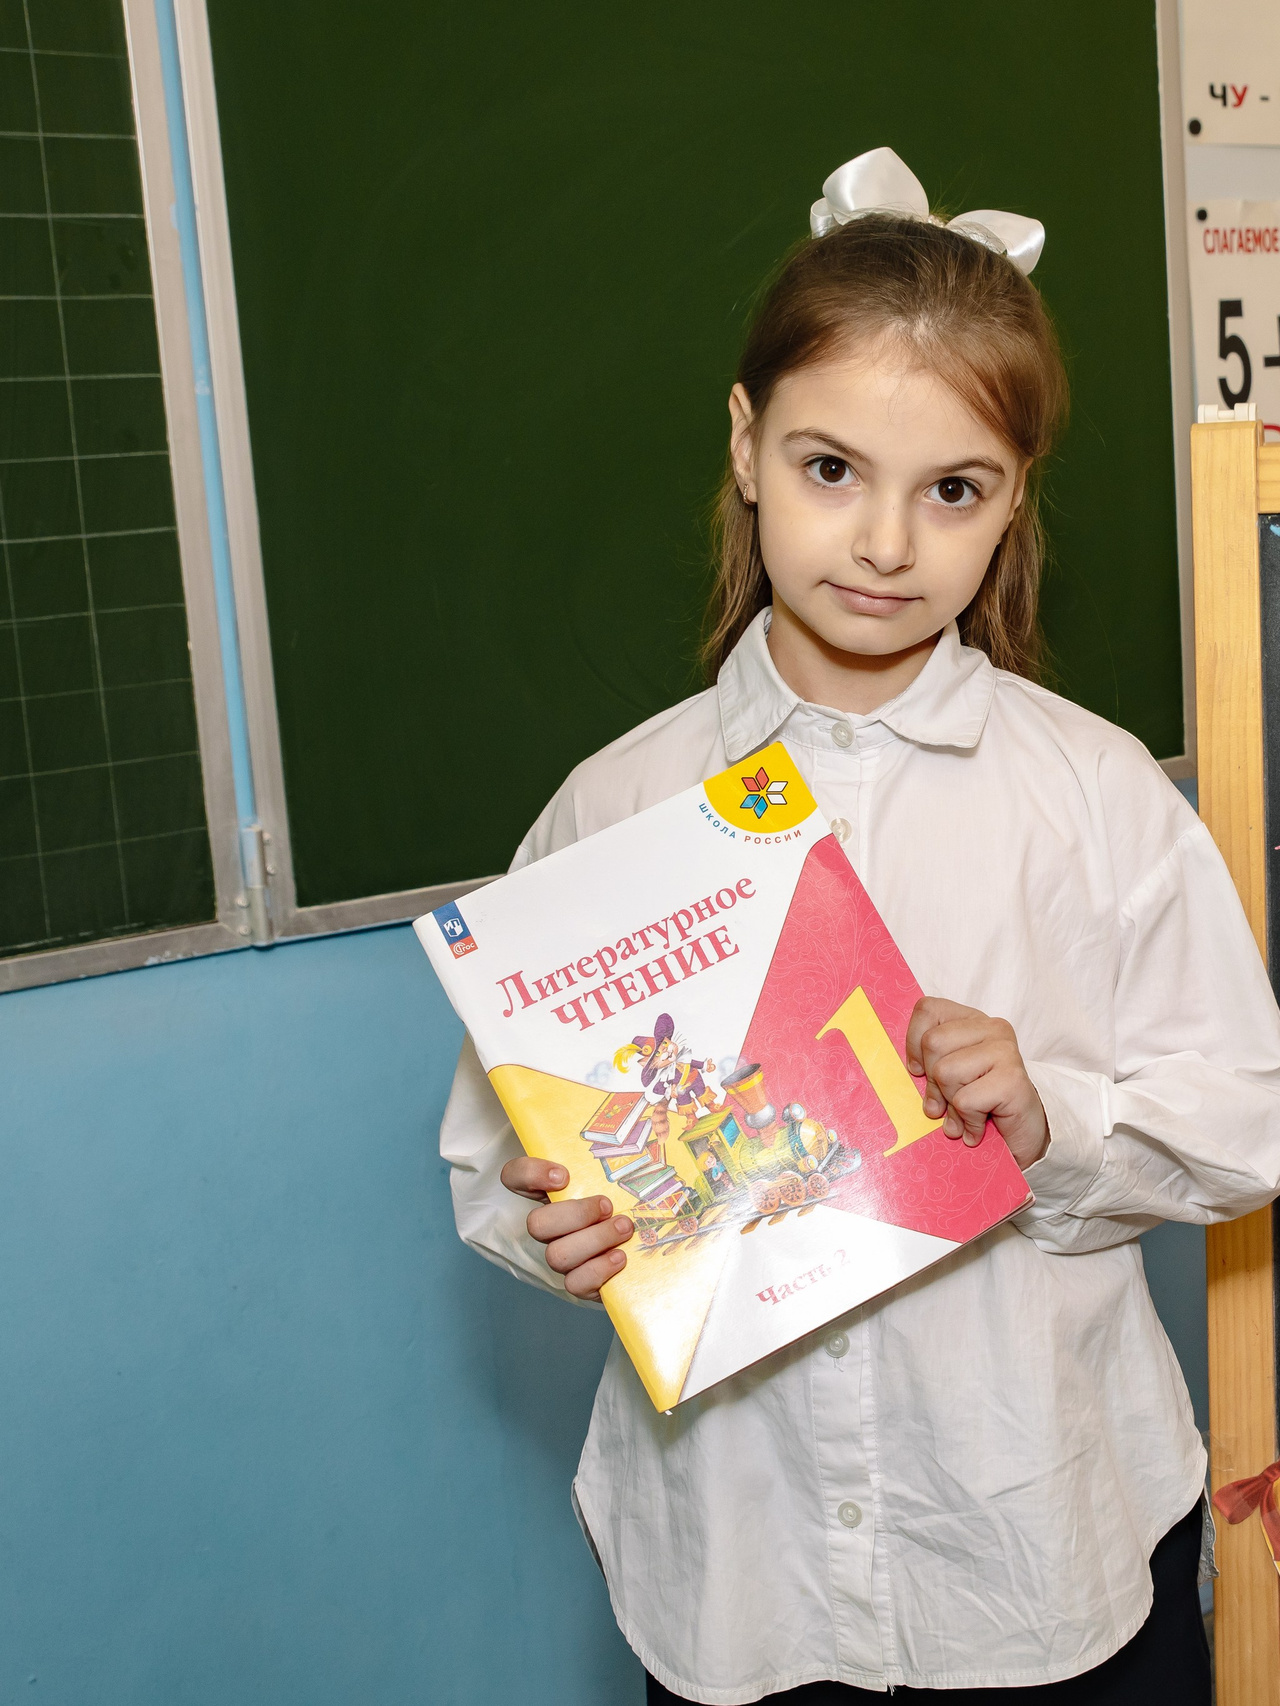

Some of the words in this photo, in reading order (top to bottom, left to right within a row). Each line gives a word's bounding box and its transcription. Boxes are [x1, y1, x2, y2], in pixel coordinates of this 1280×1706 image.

[1209, 83, 1248, 108] ЧУ
[1203, 227, 1280, 254] СЛАГАЕМОЕ
[698, 802, 737, 839] ШКОЛА
[743, 829, 802, 845] РОССИИ
[495, 877, 757, 1018] Литературное
[550, 924, 741, 1031] ЧТЕНИЕ
[815, 985, 947, 1159] 1
